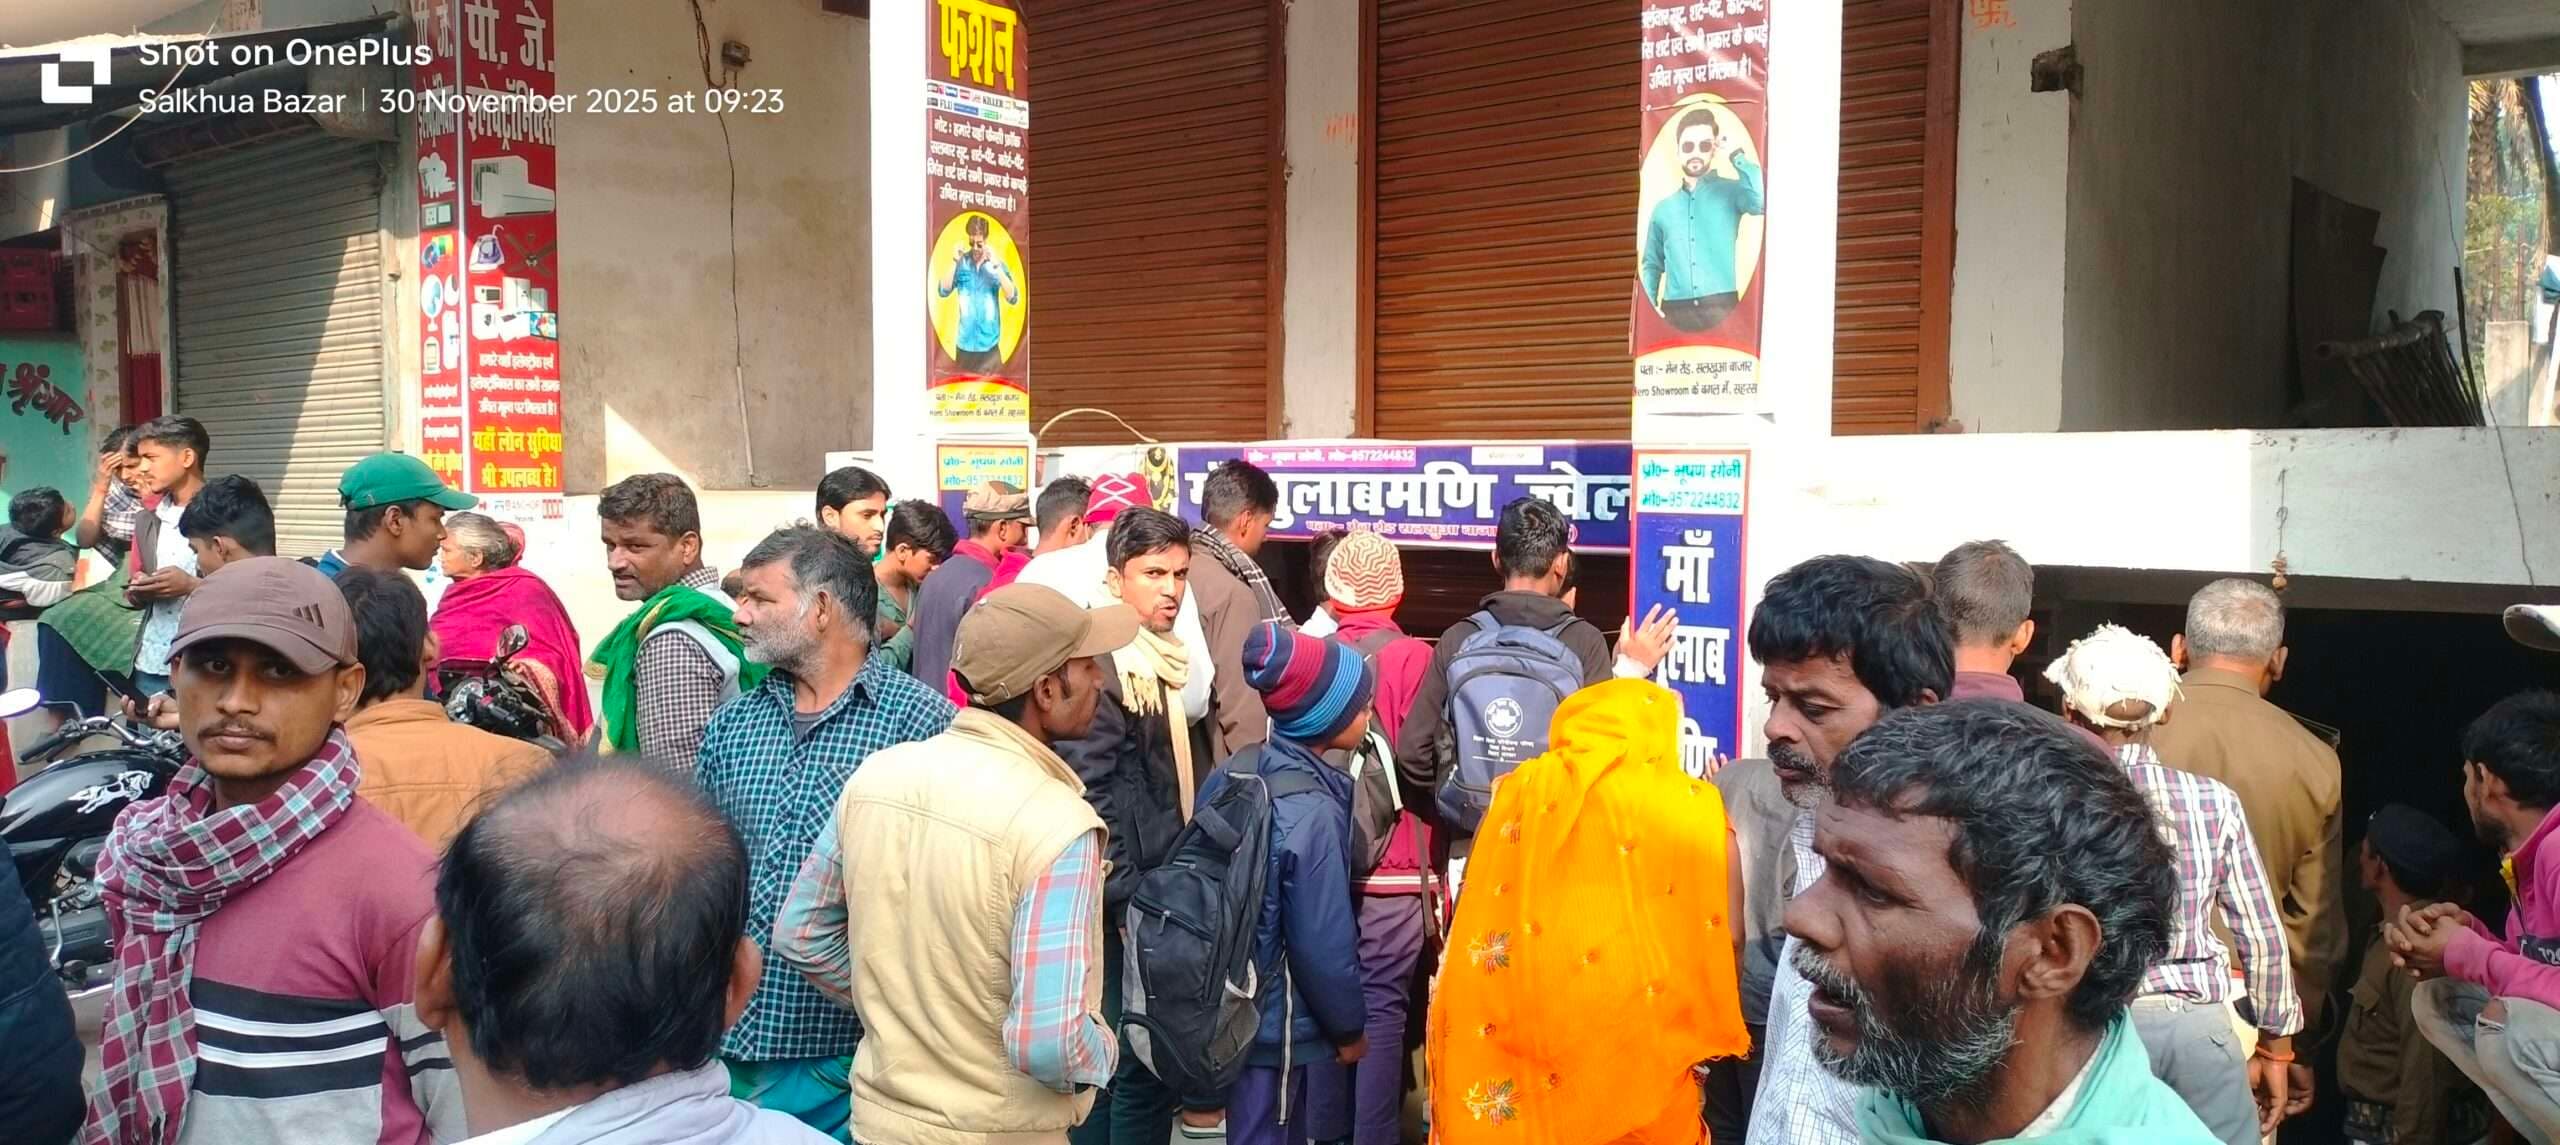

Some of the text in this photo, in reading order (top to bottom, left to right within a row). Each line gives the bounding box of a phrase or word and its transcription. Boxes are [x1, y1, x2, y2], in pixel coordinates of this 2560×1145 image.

[516, 0, 555, 73] जे.
[1652, 384, 1689, 397] Showroom
[472, 426, 496, 452] यहाँ
[497, 427, 525, 452] लोन
[527, 427, 562, 459] सुविधा
[481, 463, 496, 488] भी
[499, 467, 541, 488] उपलब्ध
[1711, 458, 1741, 479] सोनी
[1662, 529, 1715, 603] माँ
